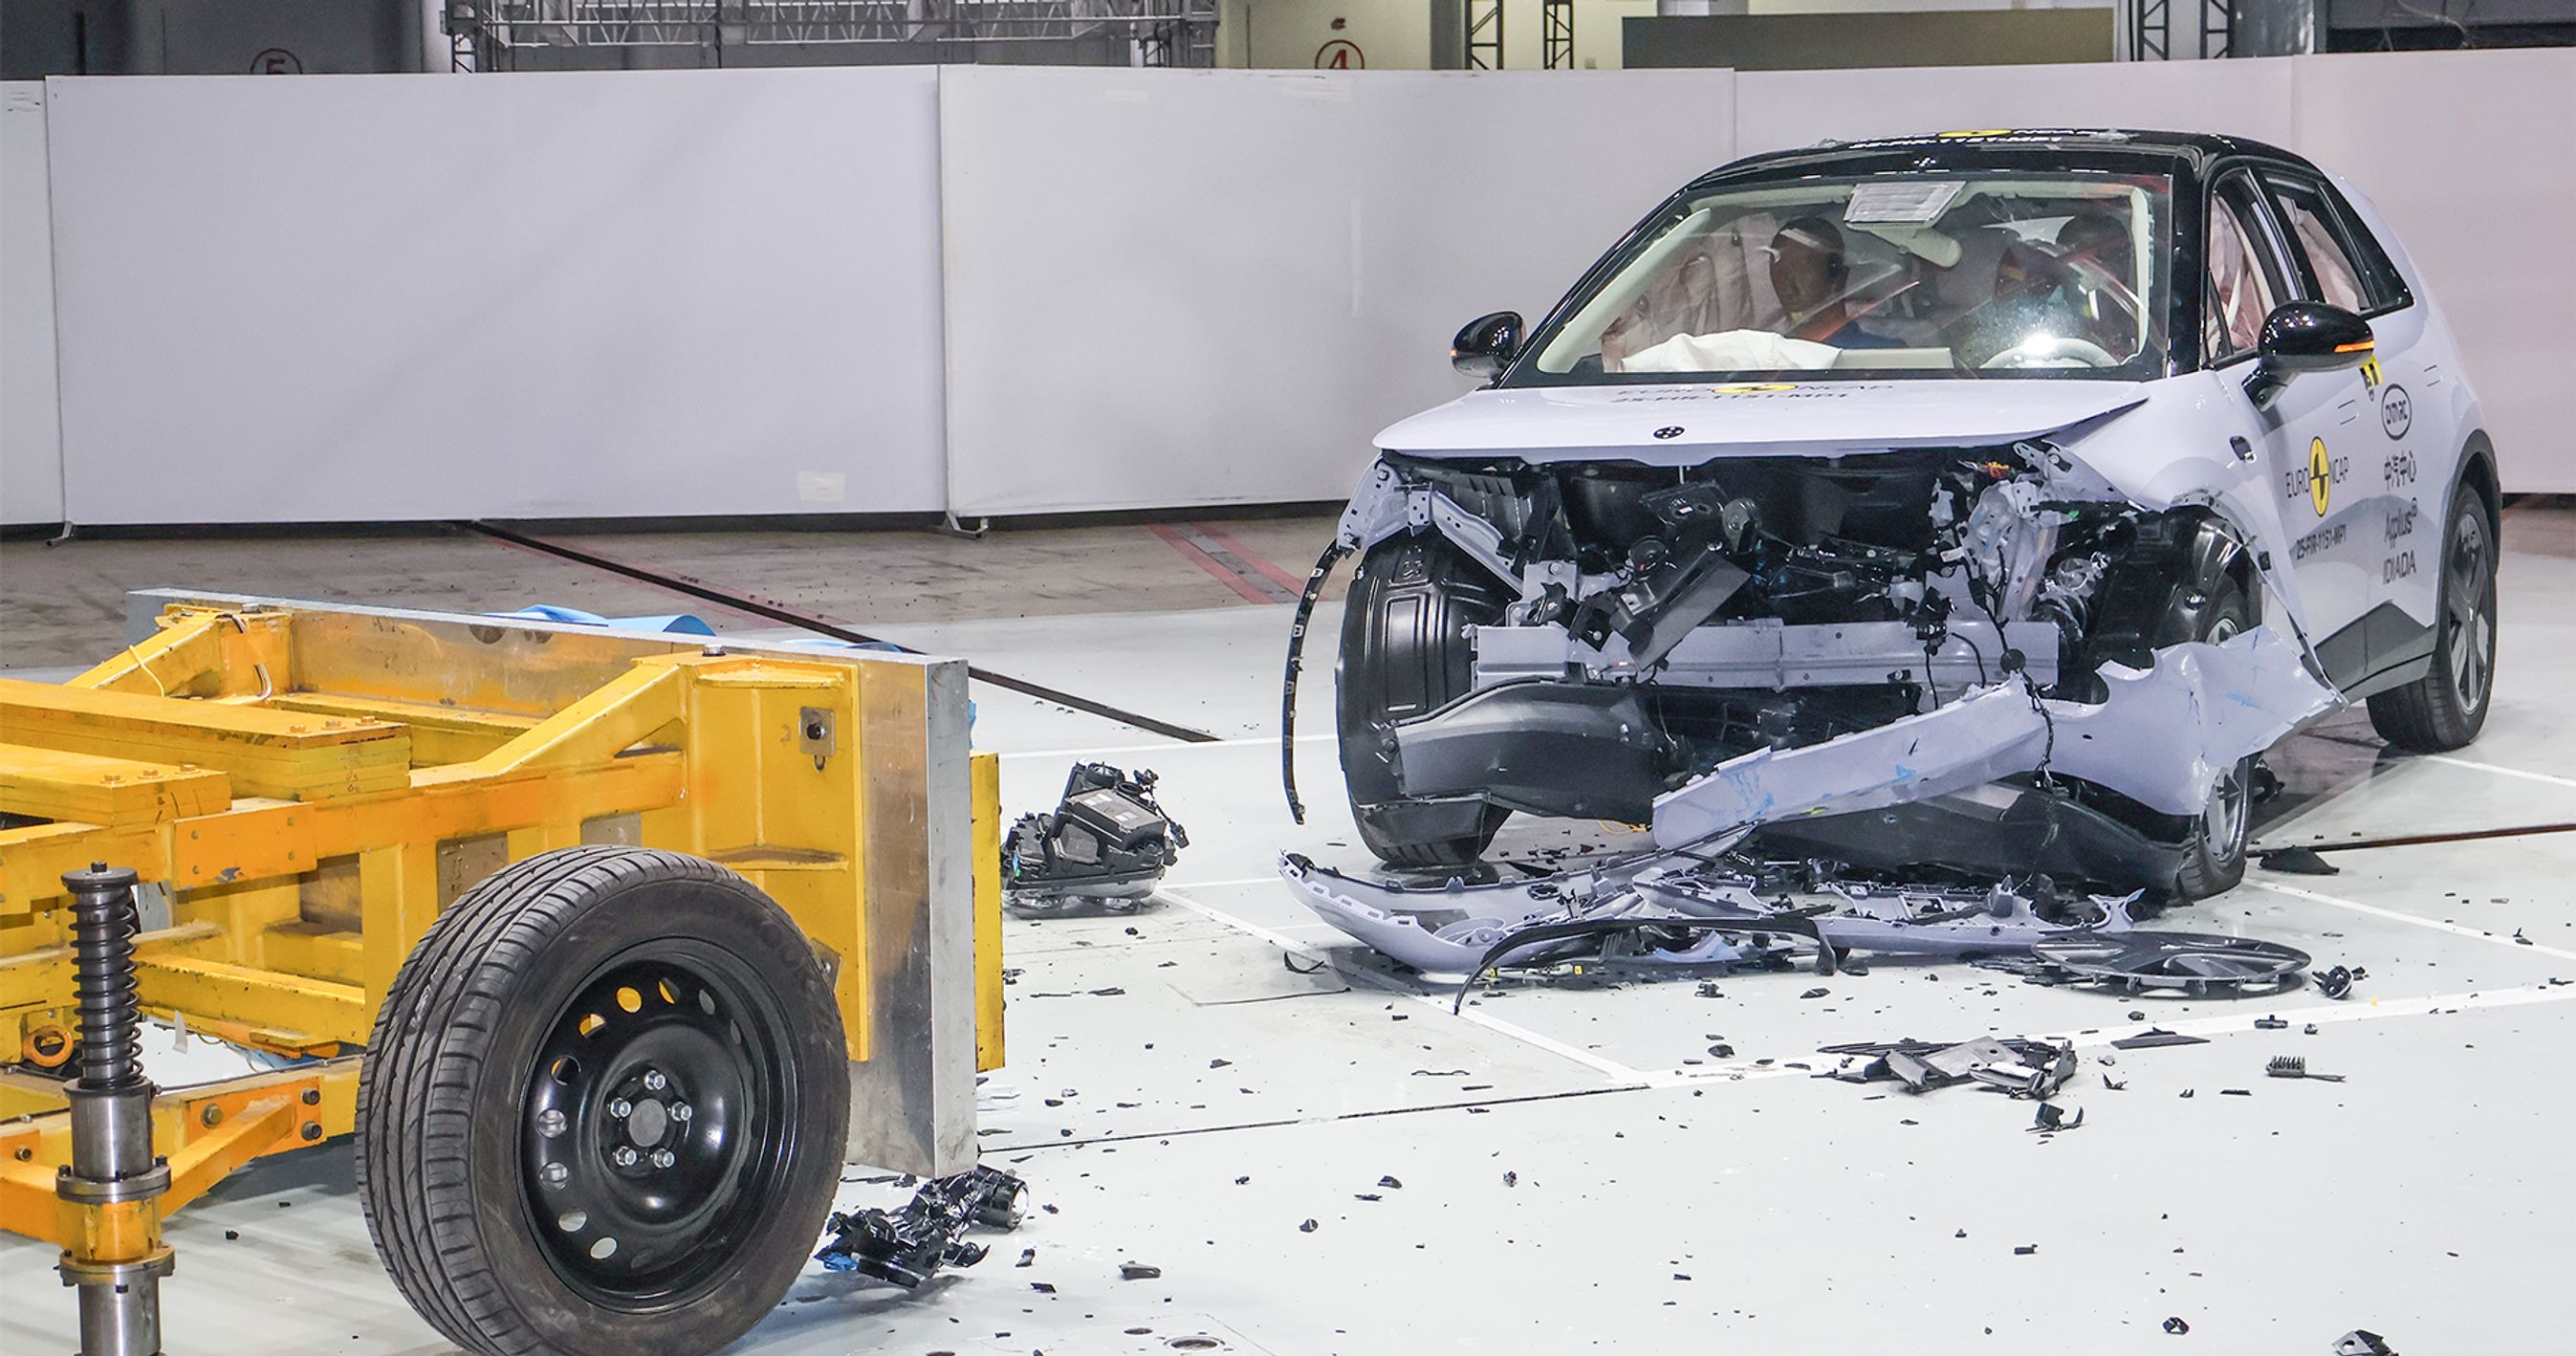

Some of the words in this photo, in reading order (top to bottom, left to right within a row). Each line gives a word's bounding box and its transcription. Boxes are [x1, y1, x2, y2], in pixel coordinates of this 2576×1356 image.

[1329, 49, 1349, 69] 4
[2285, 467, 2311, 498] EURO
[2328, 456, 2349, 484] NCAP
[2382, 550, 2417, 585] IDIADA
